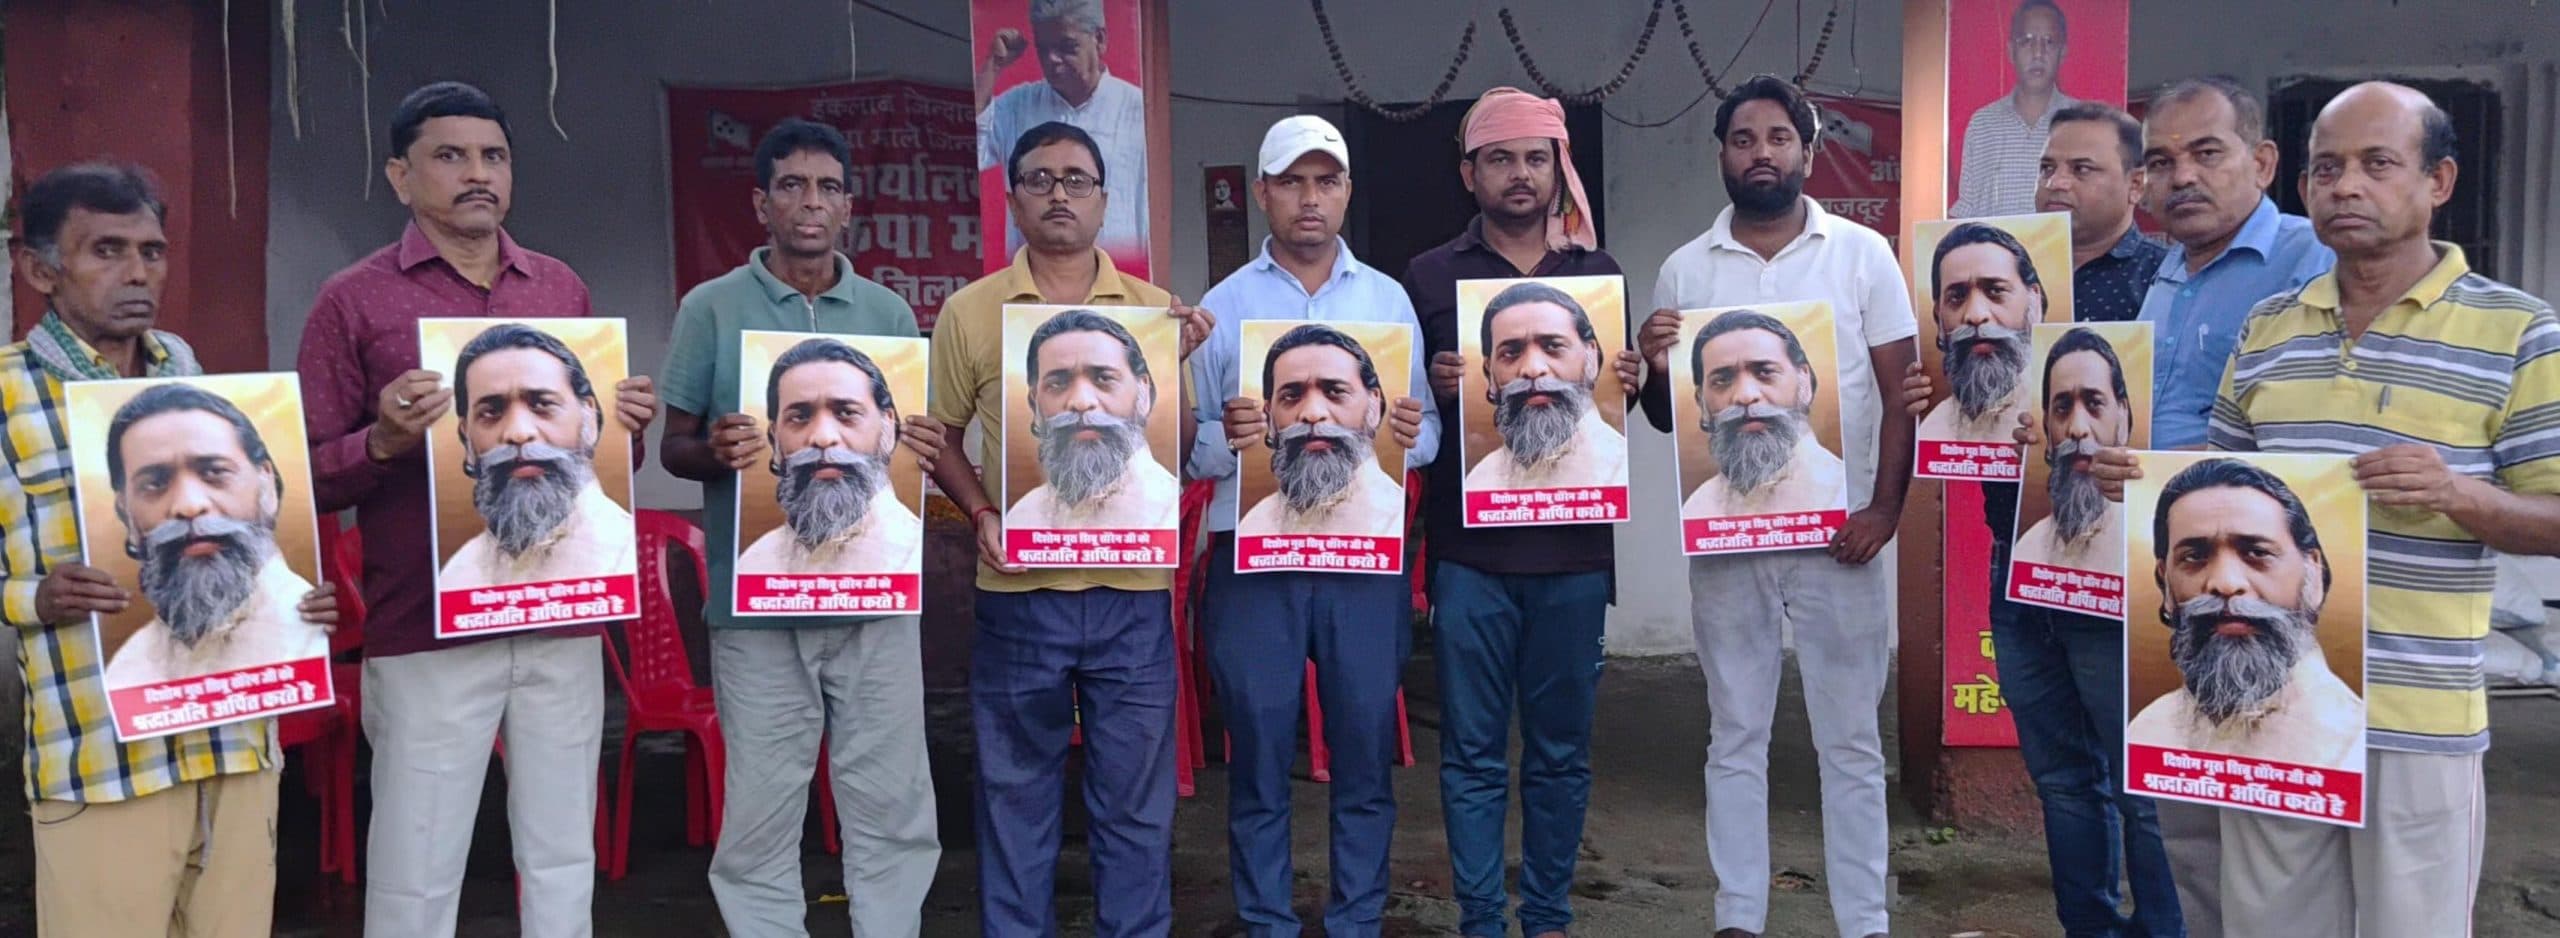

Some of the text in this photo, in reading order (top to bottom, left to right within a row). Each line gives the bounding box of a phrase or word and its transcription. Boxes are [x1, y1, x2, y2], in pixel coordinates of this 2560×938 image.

[1576, 504, 1604, 518] करते
[1795, 528, 1824, 543] करते
[1122, 547, 1152, 562] करते
[1348, 553, 1376, 568] करते
[574, 597, 609, 616] करते
[862, 592, 892, 608] करते
[1952, 673, 2006, 714] महे
[2287, 769, 2305, 784] जी
[2306, 771, 2323, 786] को
[2230, 783, 2282, 807] अर्पित
[2284, 791, 2326, 814] करते
